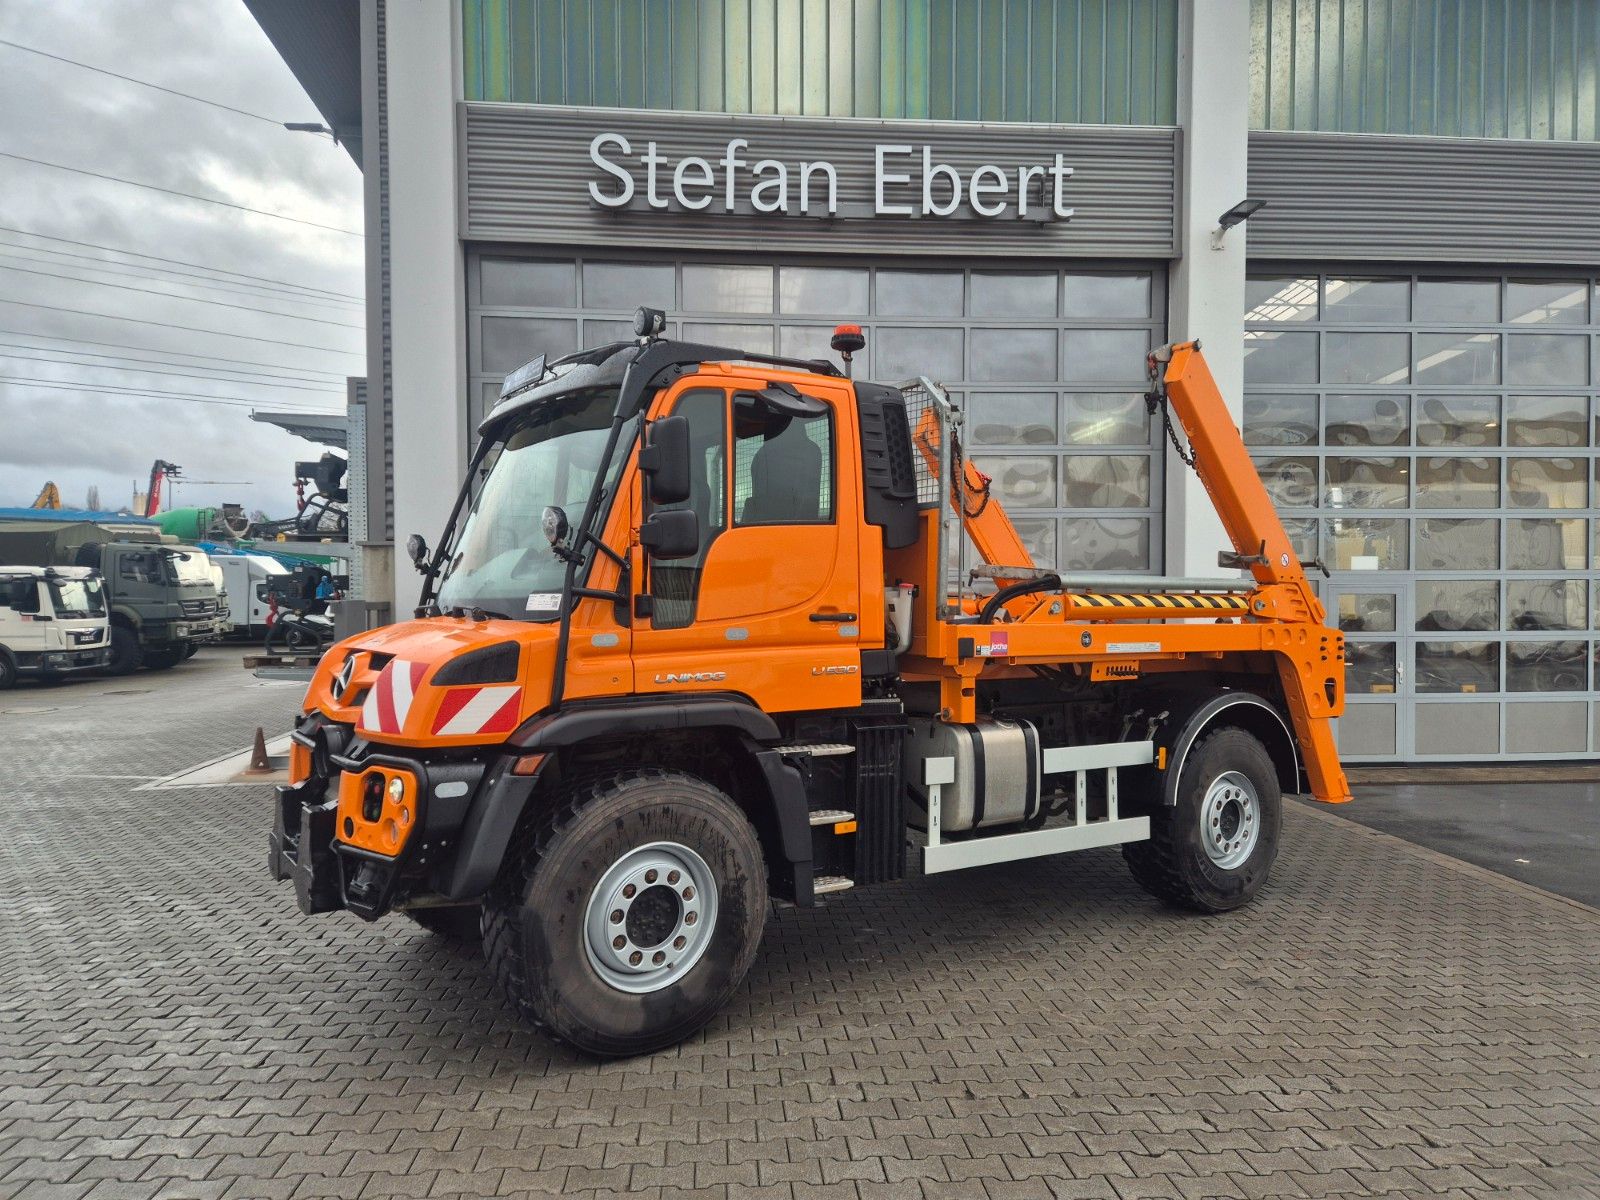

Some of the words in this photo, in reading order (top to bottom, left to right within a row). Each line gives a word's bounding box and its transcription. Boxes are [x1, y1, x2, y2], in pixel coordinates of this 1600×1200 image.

[588, 132, 838, 217] Stefan
[875, 144, 1076, 219] Ebert
[655, 672, 726, 684] UNIMOG
